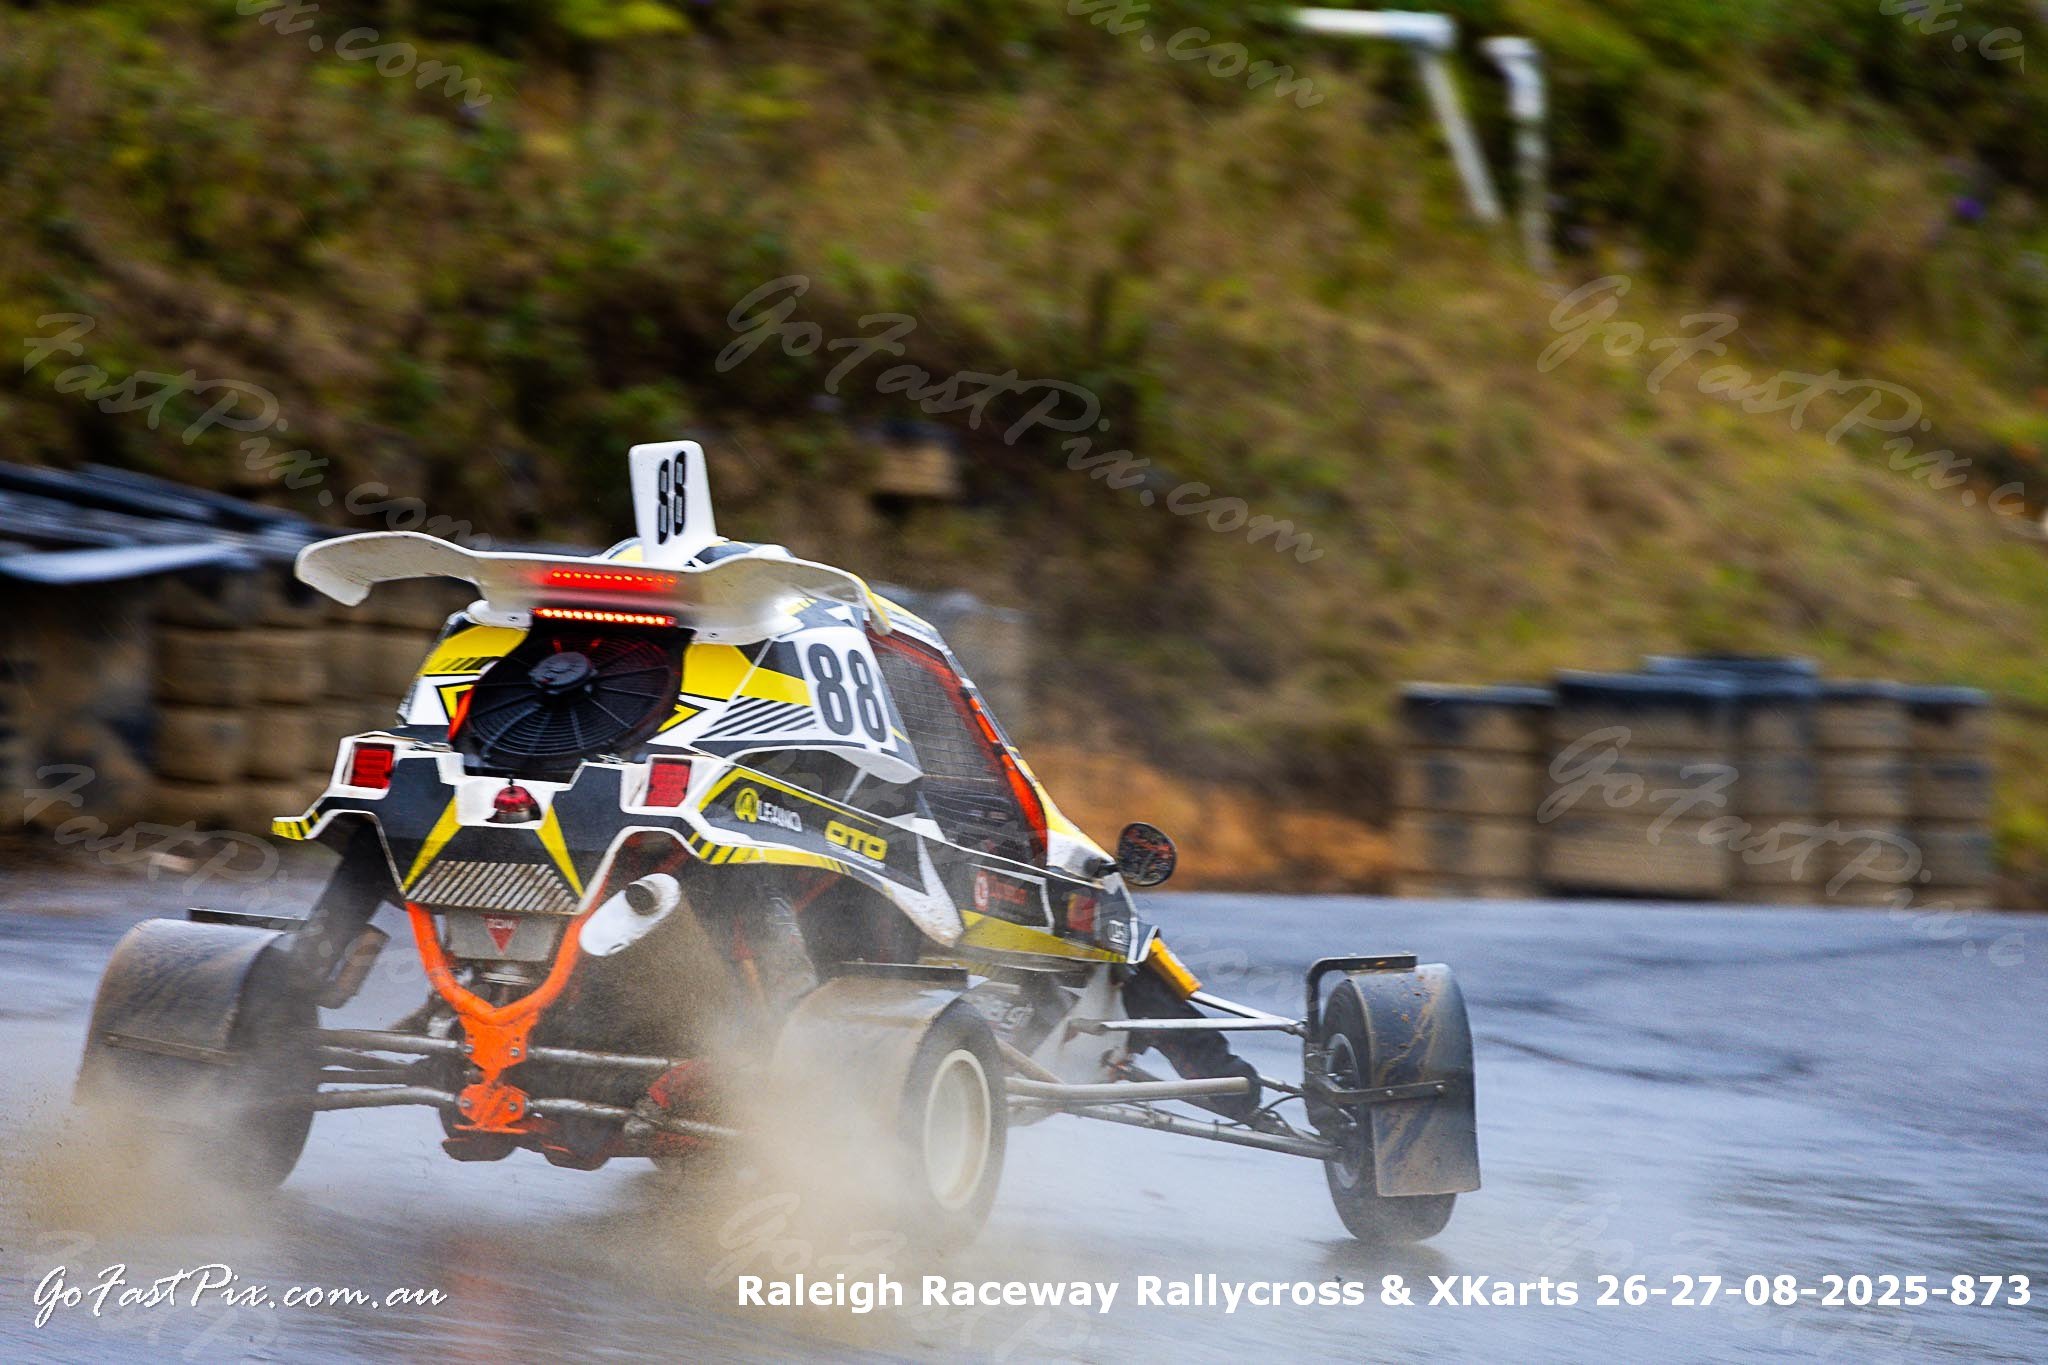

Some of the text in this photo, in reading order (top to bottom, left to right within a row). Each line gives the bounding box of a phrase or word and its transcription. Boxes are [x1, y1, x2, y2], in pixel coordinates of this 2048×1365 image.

[658, 450, 686, 545] 88
[807, 643, 887, 743] 88
[824, 820, 889, 861] OTO
